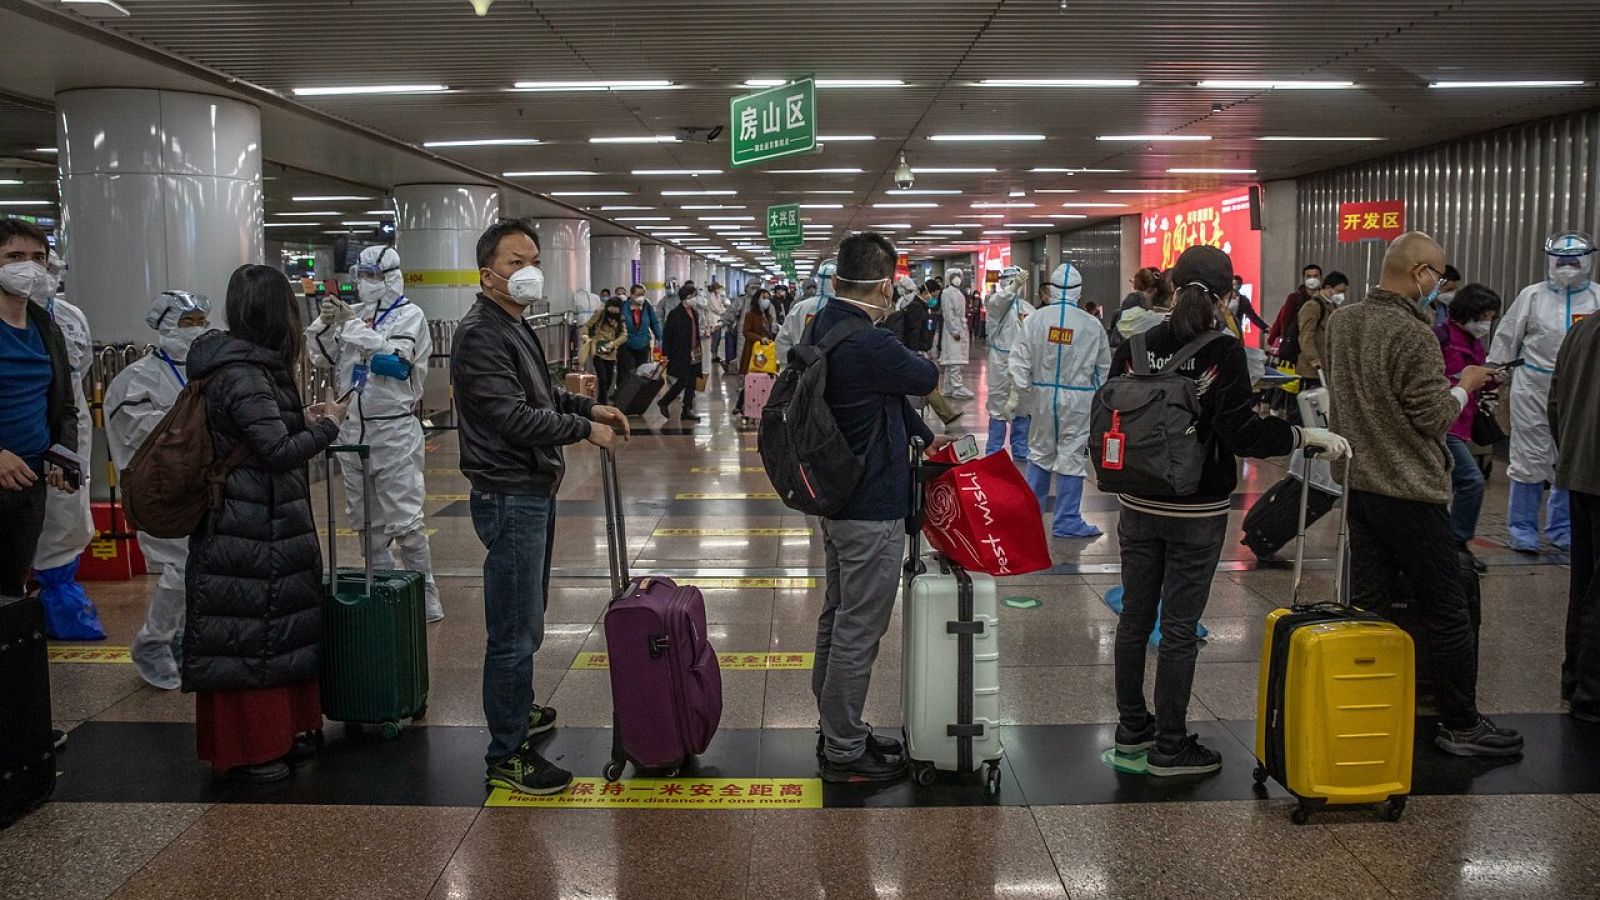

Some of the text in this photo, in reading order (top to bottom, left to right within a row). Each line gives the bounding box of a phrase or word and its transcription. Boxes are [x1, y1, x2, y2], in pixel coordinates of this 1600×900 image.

[739, 94, 805, 140] 房山区
[770, 210, 796, 227] 大兴区
[1343, 211, 1400, 231] 开发区
[1050, 329, 1071, 342] 房山
[959, 472, 994, 526] wish!
[511, 782, 804, 796] 保持一米安全距离
[558, 796, 592, 804] keep
